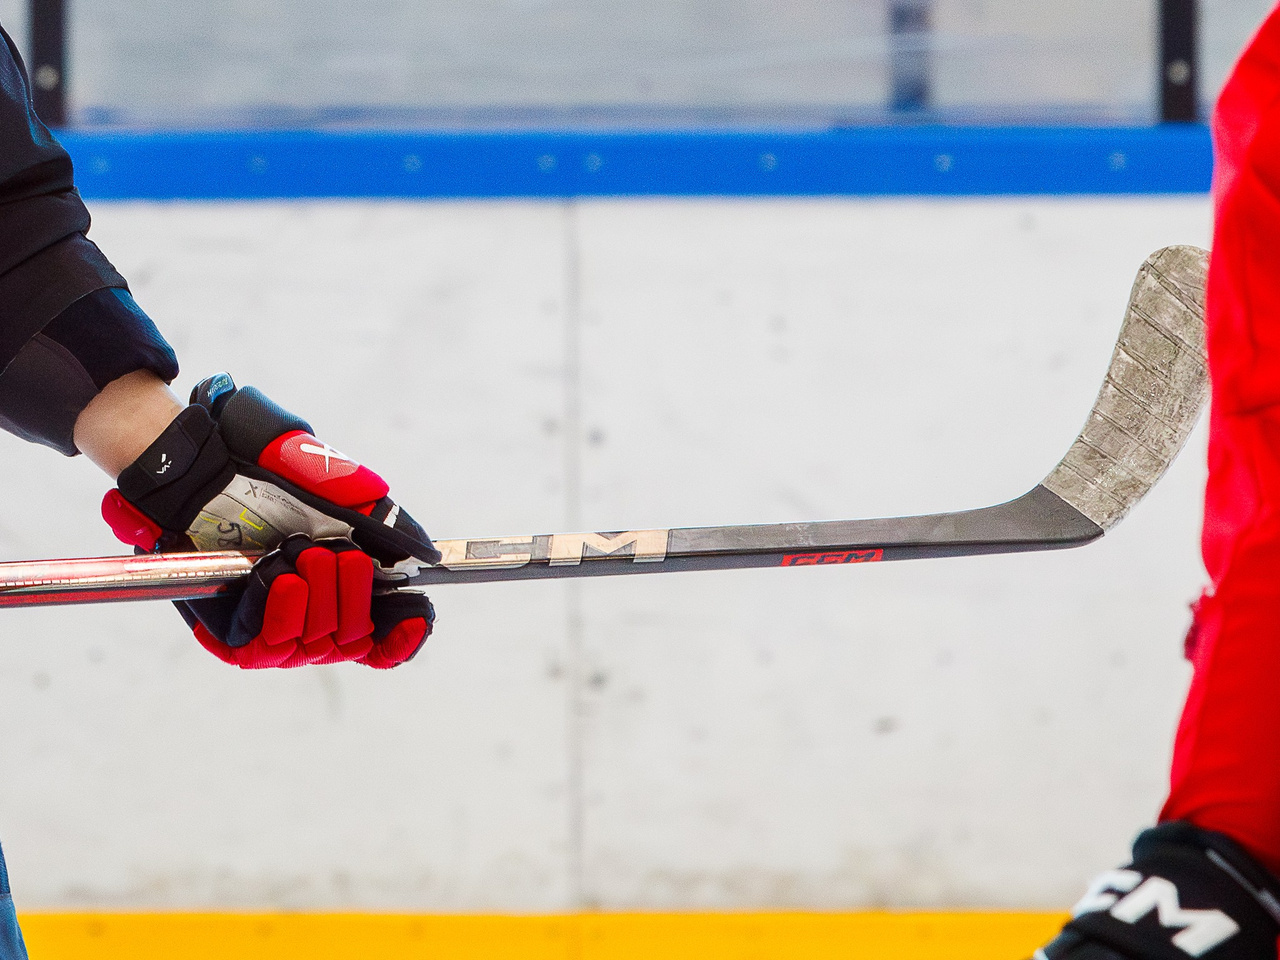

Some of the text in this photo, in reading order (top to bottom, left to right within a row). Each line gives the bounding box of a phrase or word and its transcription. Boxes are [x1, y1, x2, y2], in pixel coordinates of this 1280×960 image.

[431, 529, 669, 571] CM
[789, 551, 876, 566] CCM
[1074, 869, 1240, 957] CM
